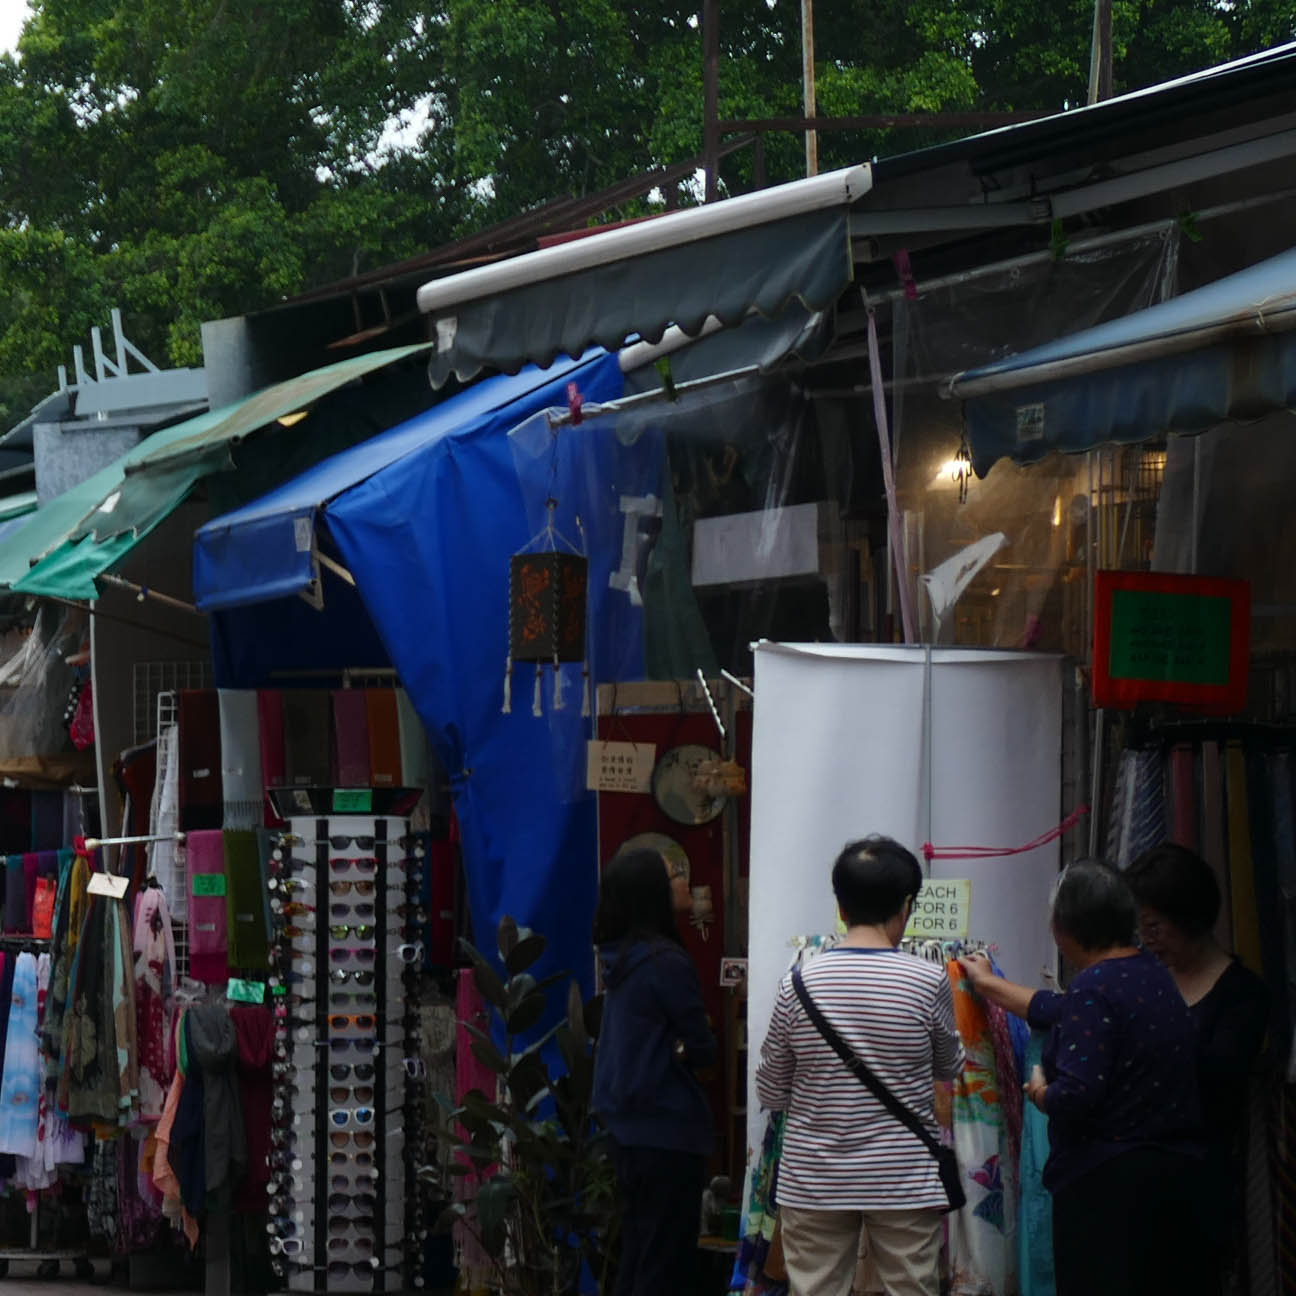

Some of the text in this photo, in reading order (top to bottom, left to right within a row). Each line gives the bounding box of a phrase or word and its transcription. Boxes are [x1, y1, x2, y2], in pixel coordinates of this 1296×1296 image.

[917, 886, 957, 898] EACH
[913, 901, 958, 914] FOR 6
[913, 917, 958, 930] FOR 6
